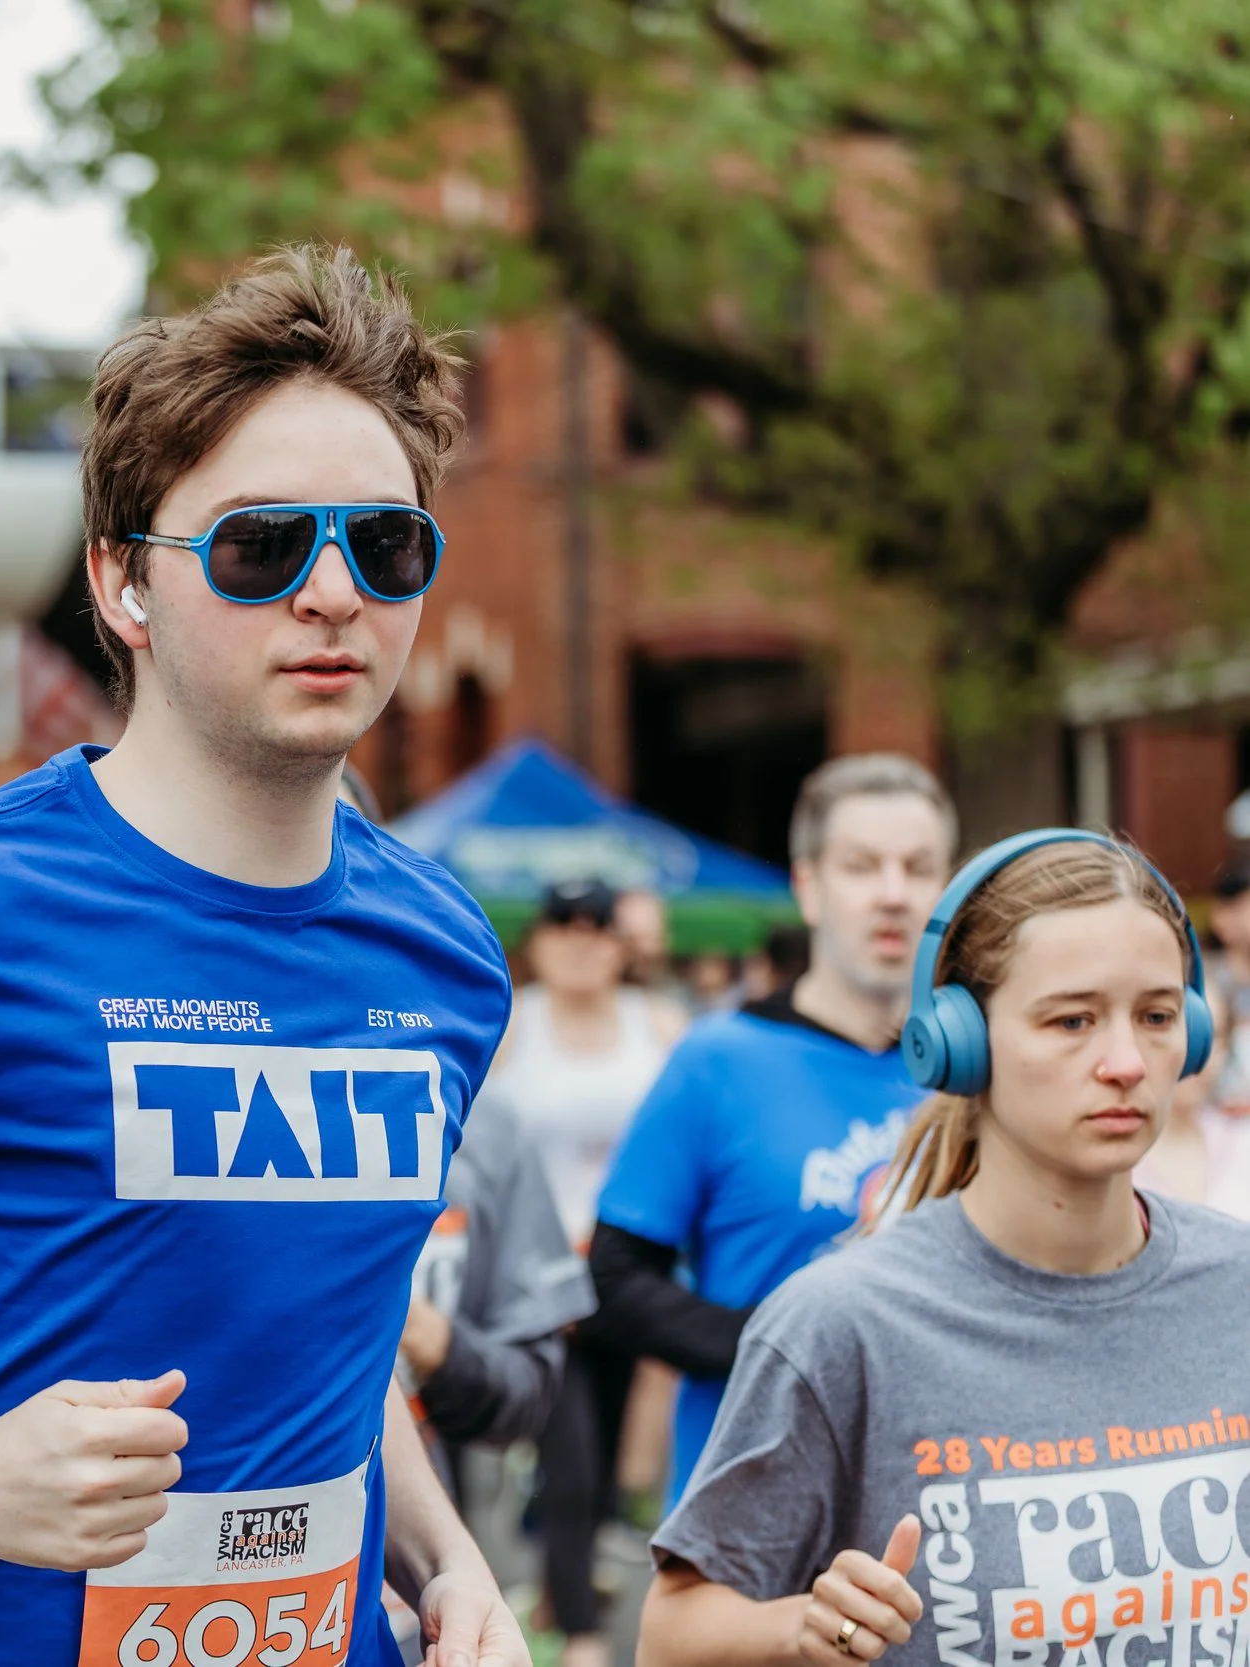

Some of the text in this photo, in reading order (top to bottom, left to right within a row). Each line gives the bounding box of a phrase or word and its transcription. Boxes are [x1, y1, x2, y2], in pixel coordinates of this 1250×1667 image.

[98, 998, 260, 1017] CREATE MOMENTS
[367, 1008, 433, 1028] EST 1978
[101, 1013, 274, 1033] THAT MOVE PEOPLE
[133, 1063, 435, 1179] TAIT
[913, 1437, 972, 1476] 28
[979, 1435, 1098, 1471] Years
[236, 1505, 309, 1537] race
[978, 1470, 1250, 1590] rac
[217, 1510, 234, 1561] ywca
[231, 1536, 306, 1561] RACISM
[235, 1528, 305, 1549] against
[216, 1555, 303, 1572] LANCASTER, PA
[117, 1578, 348, 1667] 6054
